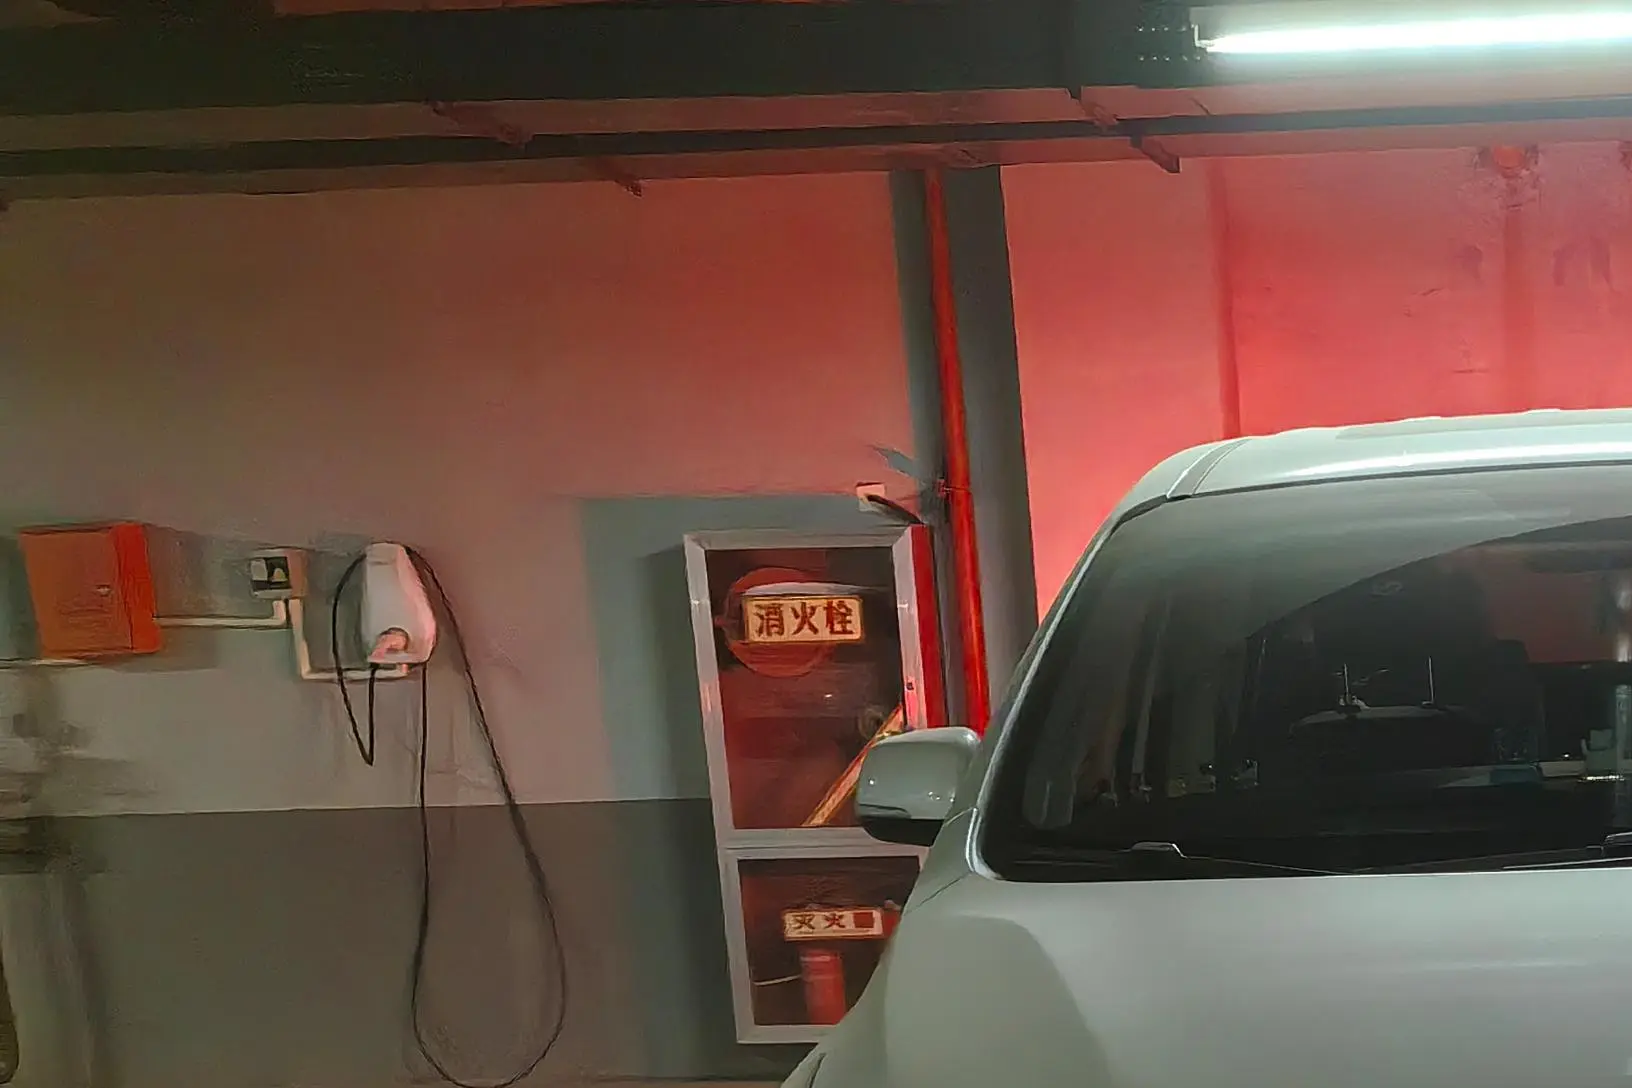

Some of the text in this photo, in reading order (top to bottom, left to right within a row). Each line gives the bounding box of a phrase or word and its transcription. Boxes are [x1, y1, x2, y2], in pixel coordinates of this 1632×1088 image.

[753, 600, 855, 637] 消火栓
[791, 911, 876, 930] 灭火
